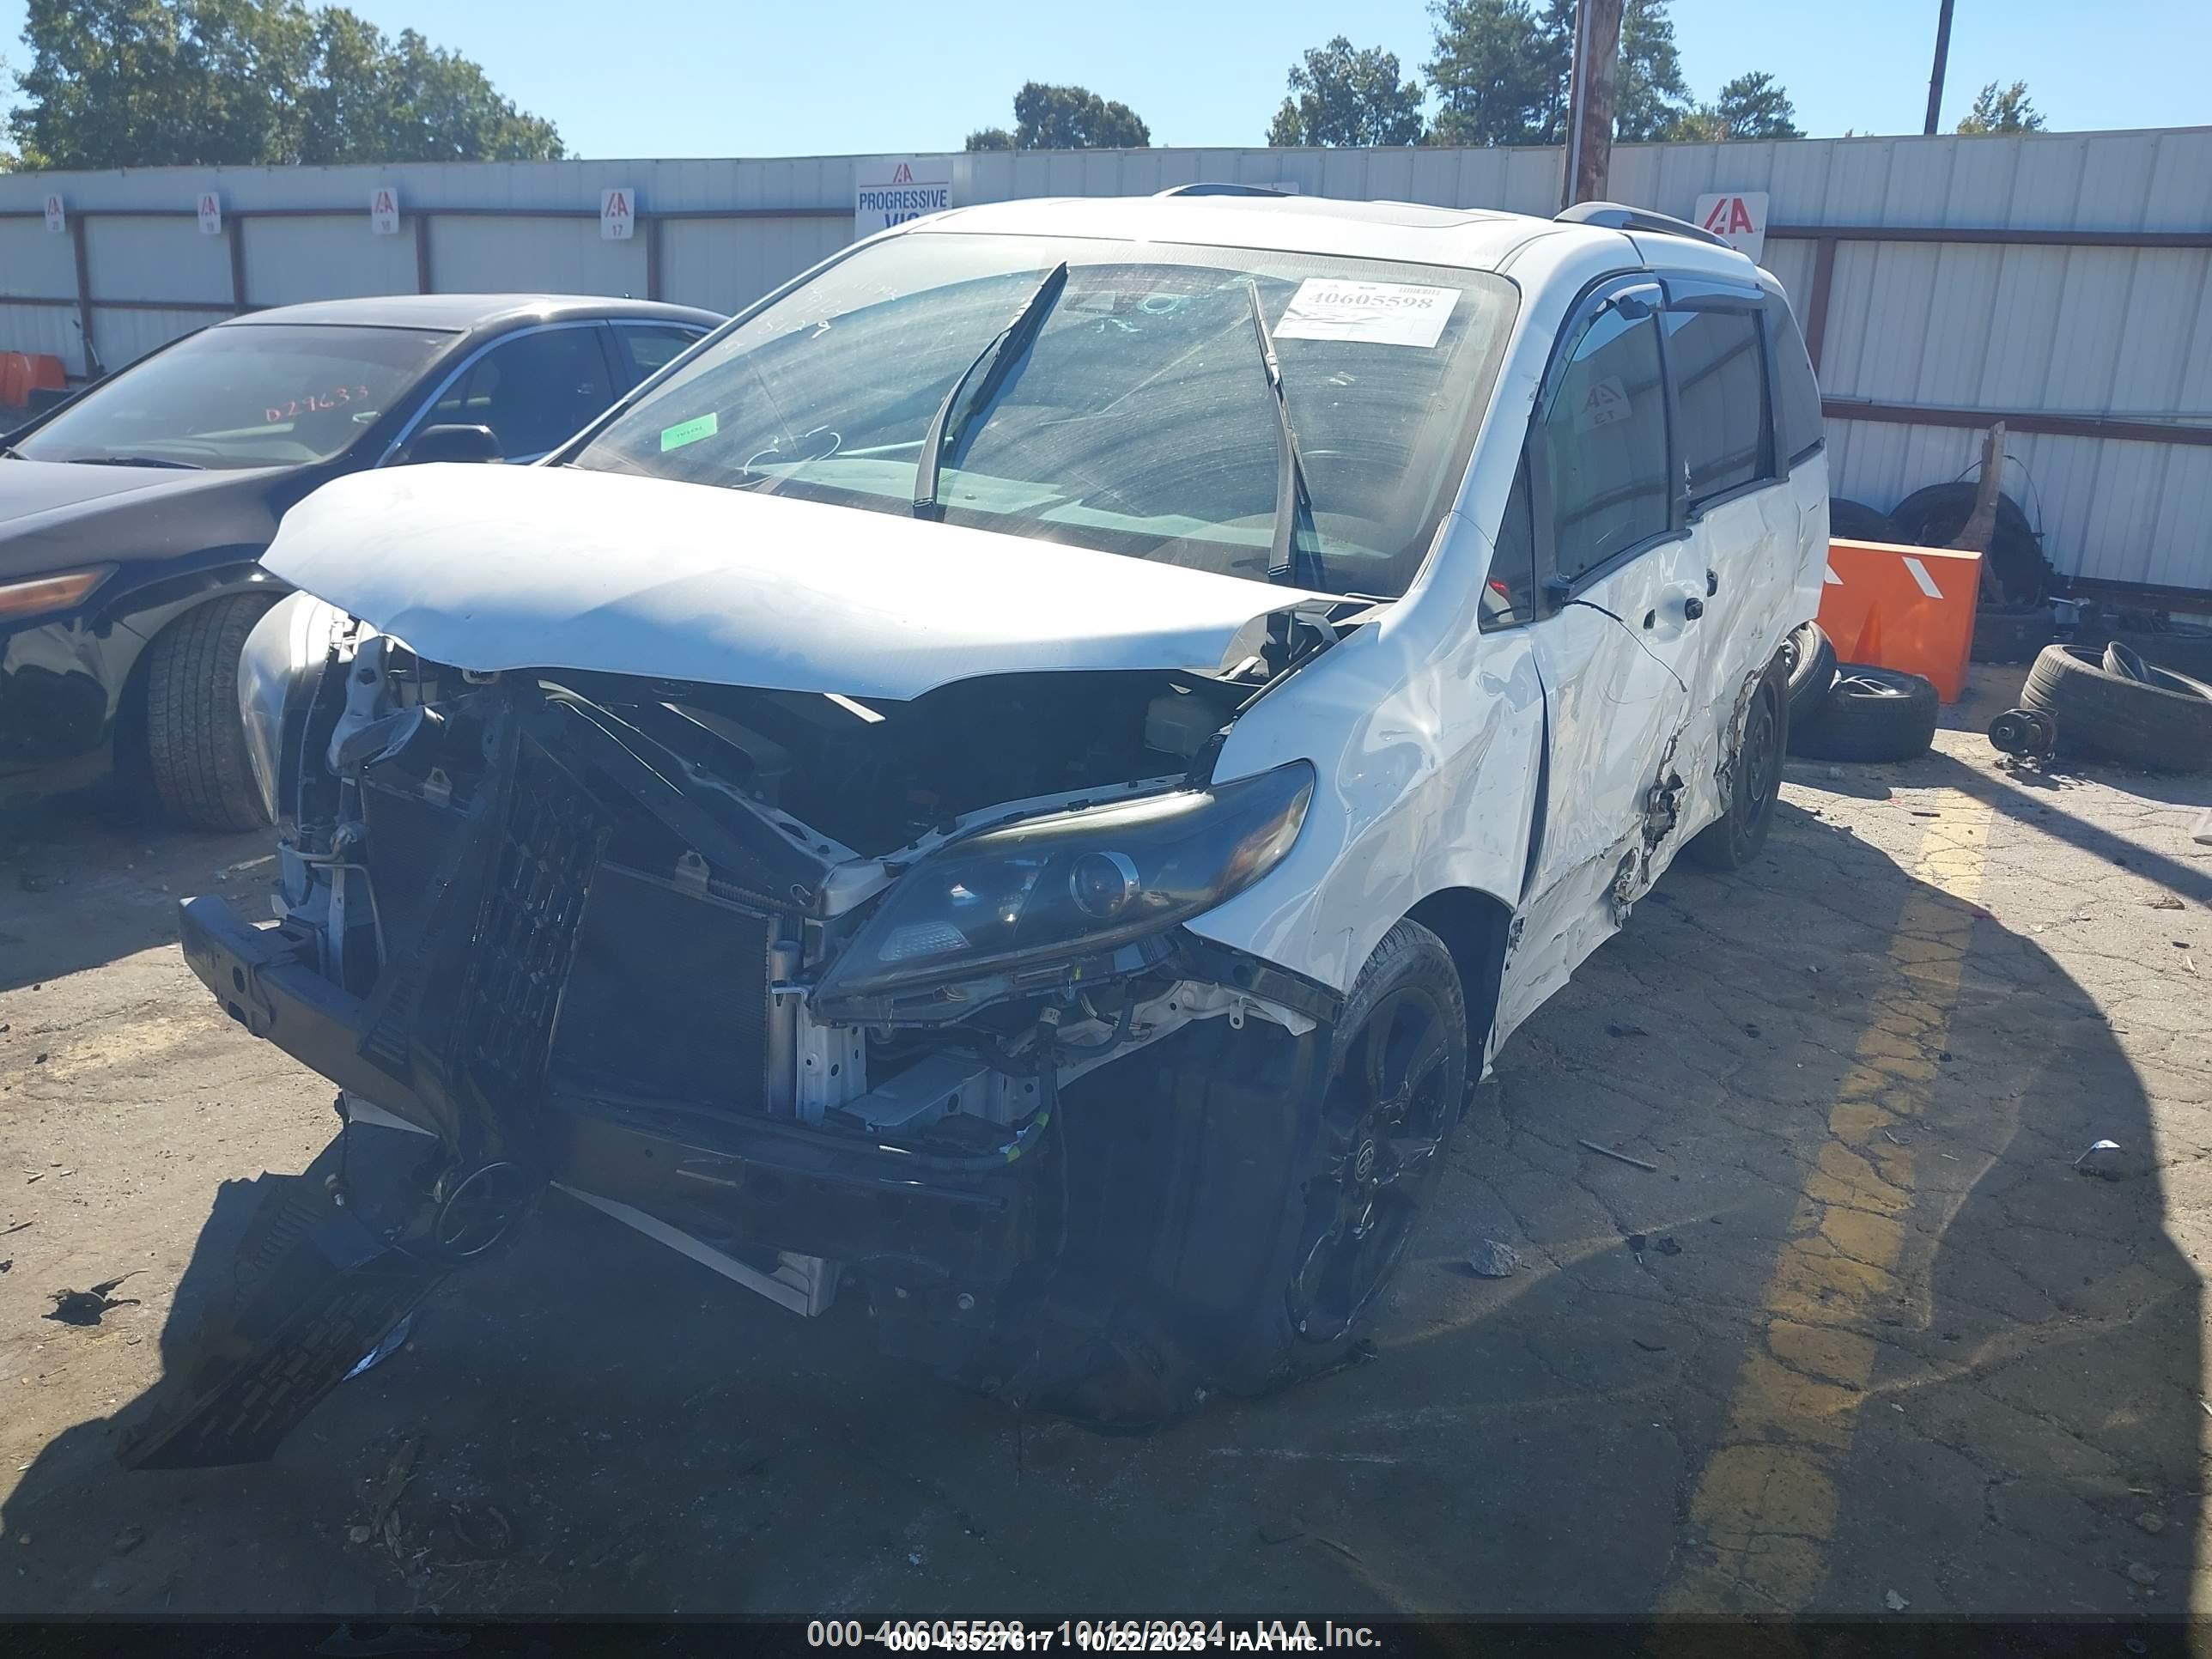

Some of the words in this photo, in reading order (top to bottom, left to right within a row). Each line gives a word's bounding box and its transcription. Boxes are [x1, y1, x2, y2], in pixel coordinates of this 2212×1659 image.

[859, 189, 947, 210] PROGRESSIVE
[612, 224, 623, 236] 17
[1309, 291, 1434, 310] 40605598
